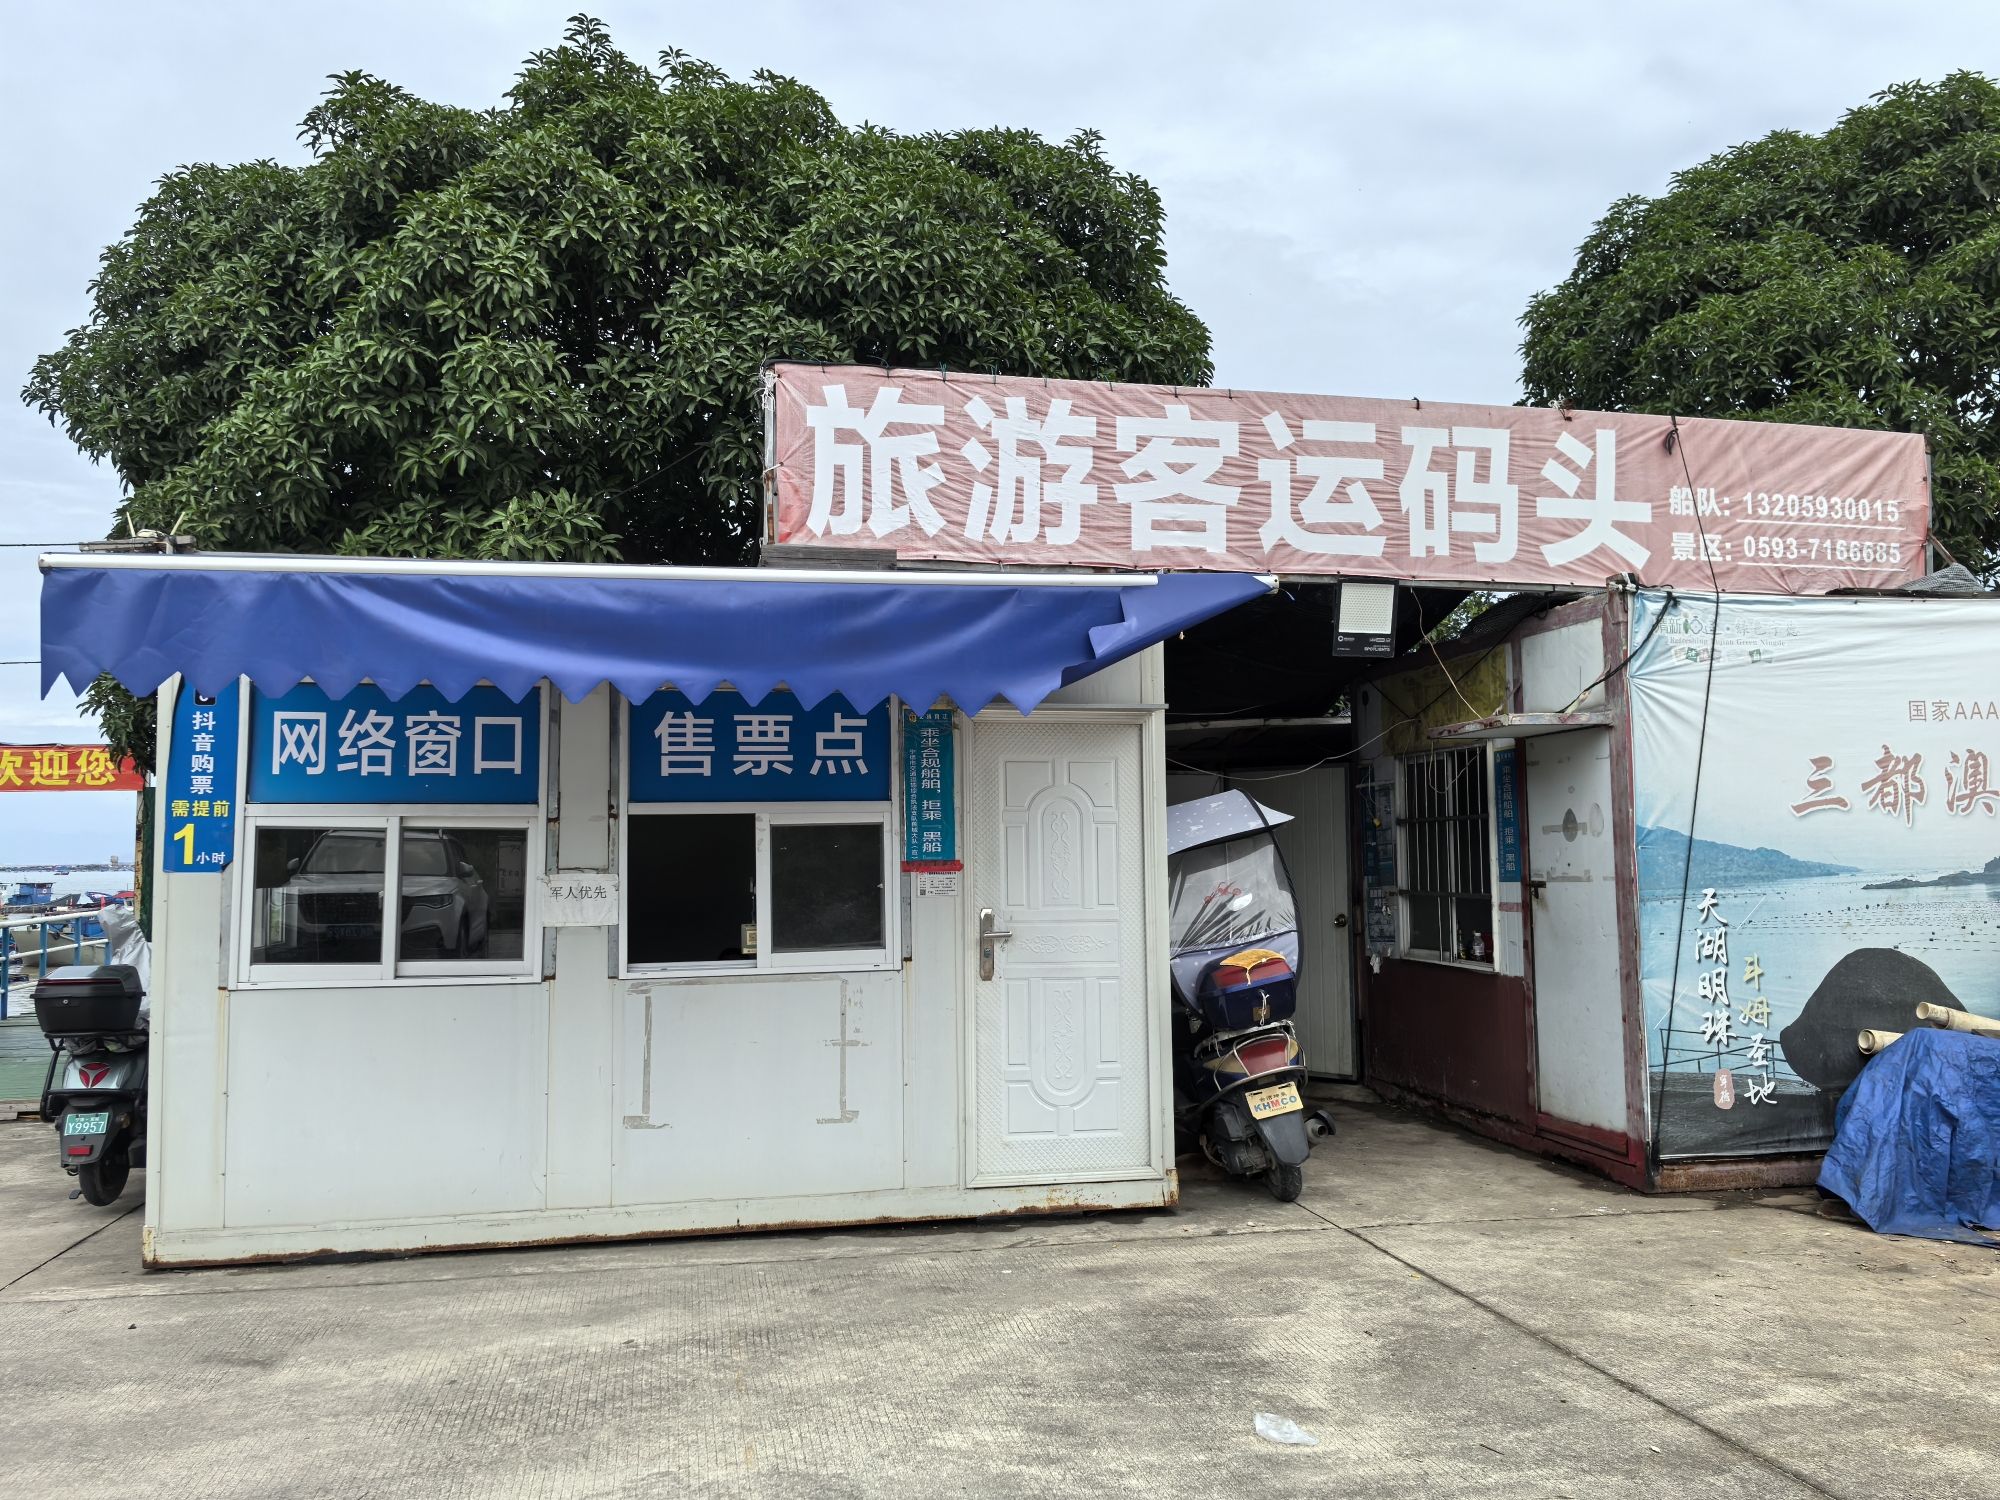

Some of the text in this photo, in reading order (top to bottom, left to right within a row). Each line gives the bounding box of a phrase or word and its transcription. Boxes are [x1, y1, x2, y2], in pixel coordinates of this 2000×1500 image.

[806, 384, 1652, 566] 旅游客运码头
[1743, 492, 1899, 522] 13205930015
[1744, 536, 1901, 564] 0593-7166685
[1909, 699, 2000, 722] 国家AAA
[190, 711, 216, 795] 抖音购票
[271, 709, 523, 777] 网络窗口
[654, 711, 868, 777] 售票点
[1790, 743, 2000, 827] 三都澳
[172, 799, 230, 818] 需提前
[173, 823, 226, 865] 1 小时
[550, 885, 607, 901] 军人优先
[1695, 887, 1736, 1047] 天湖明珠
[1739, 952, 1777, 1105] 斗姆圣地
[1253, 1095, 1297, 1113] KHMCO
[68, 1121, 105, 1134] Y9957
